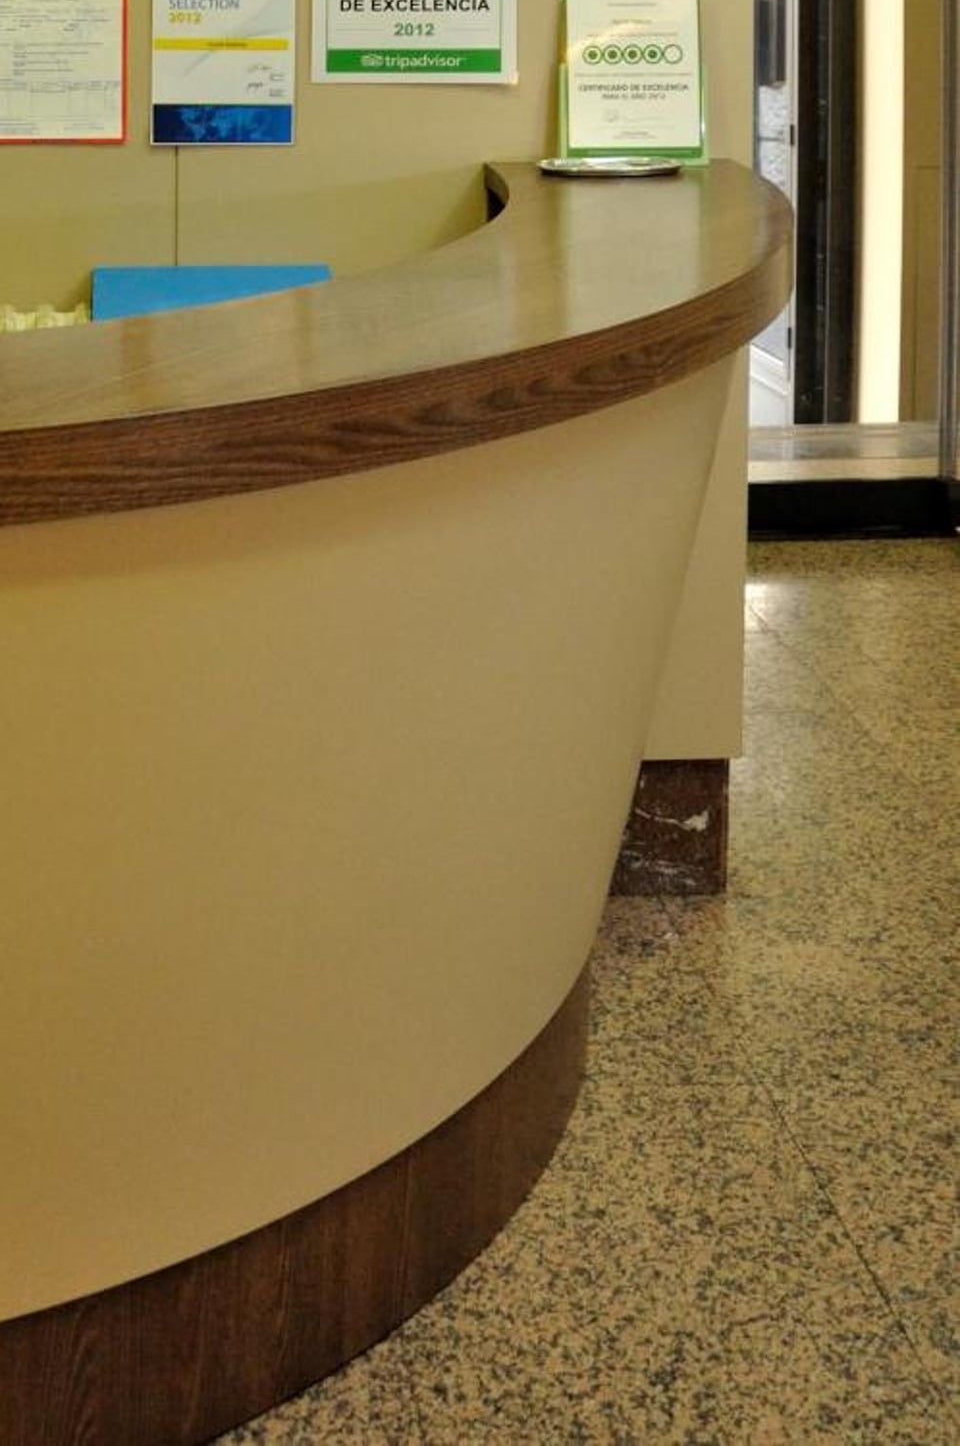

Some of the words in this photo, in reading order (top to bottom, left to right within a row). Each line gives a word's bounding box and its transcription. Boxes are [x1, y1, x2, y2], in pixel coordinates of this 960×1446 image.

[393, 23, 435, 37] 2012
[385, 54, 462, 69] tripadvisor
[578, 84, 628, 92] CERTIFICADO
[629, 84, 642, 92] DE
[642, 83, 690, 92] EXCELENCIA
